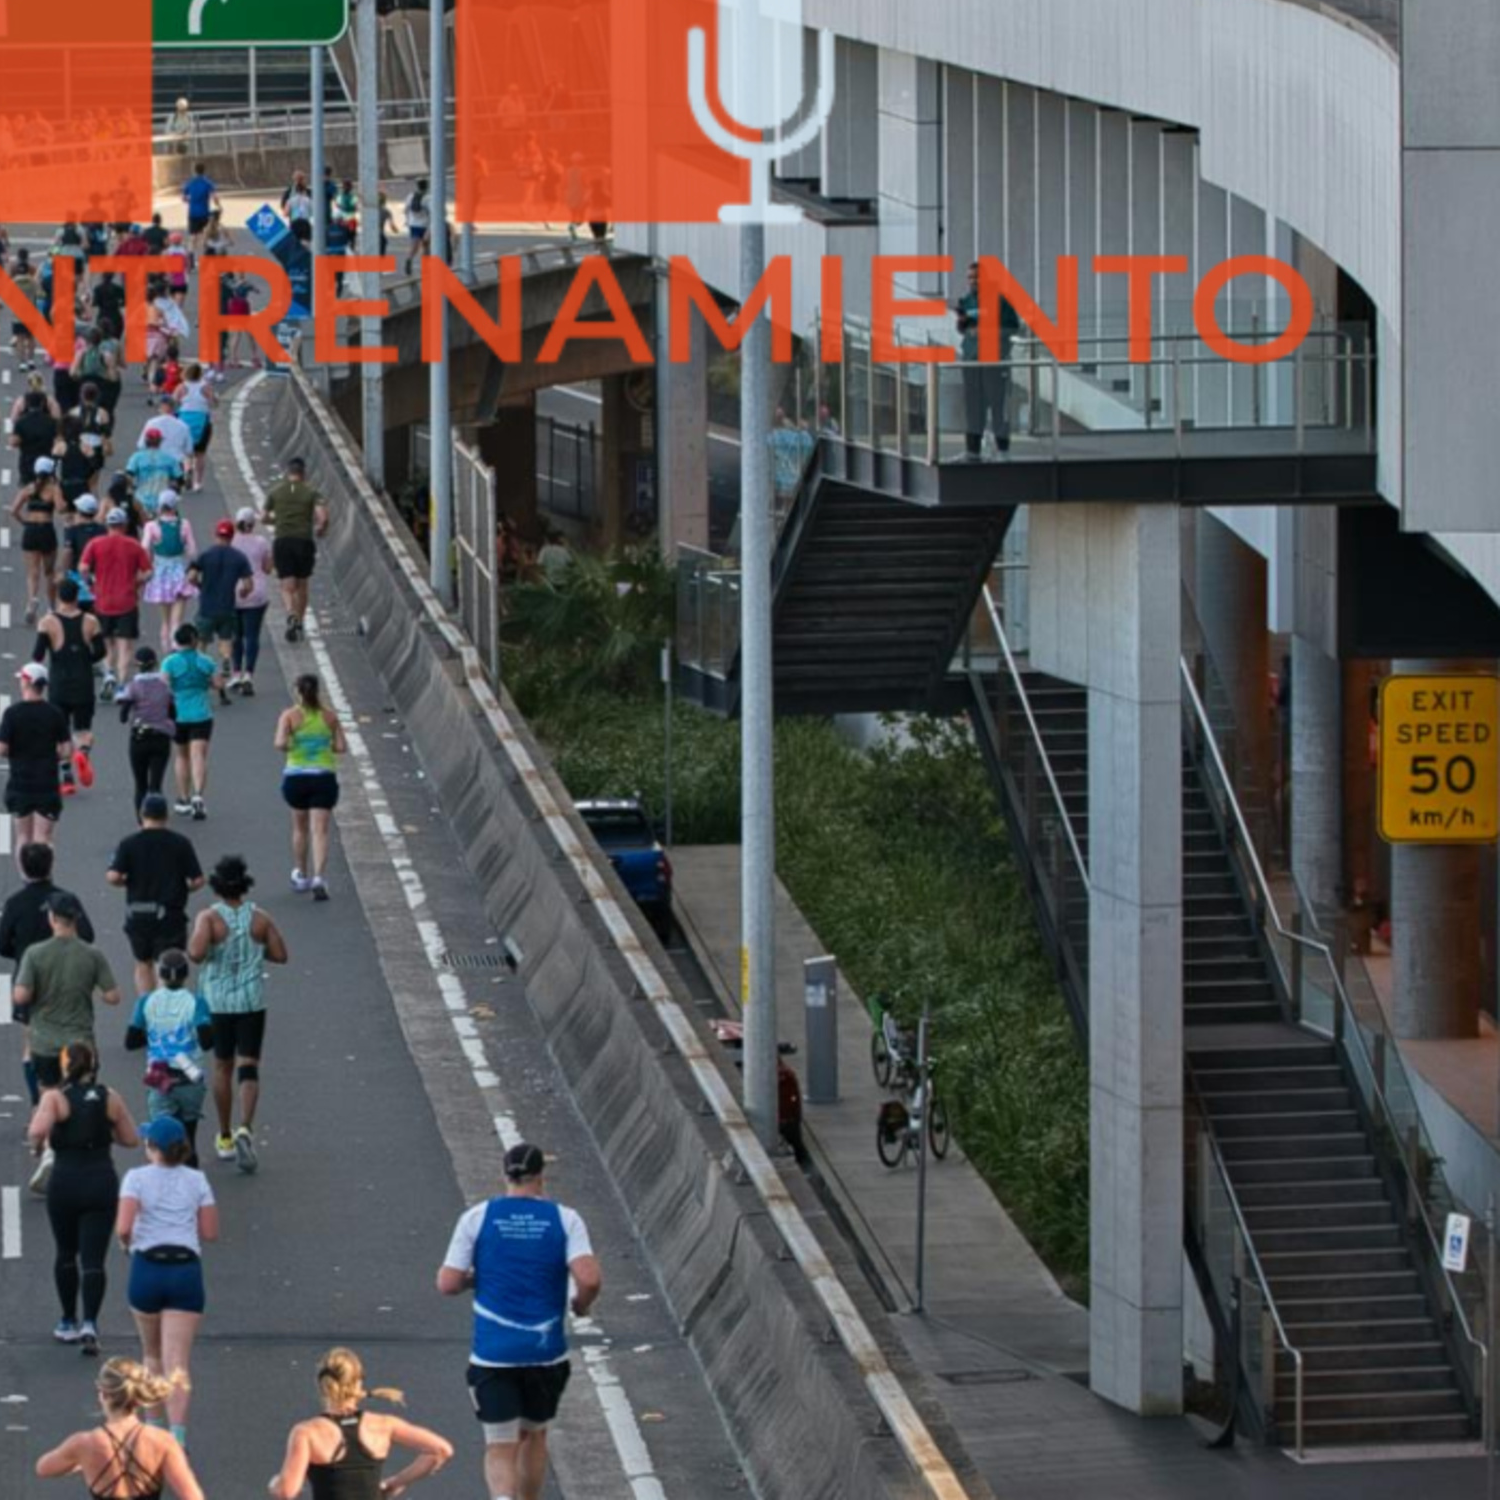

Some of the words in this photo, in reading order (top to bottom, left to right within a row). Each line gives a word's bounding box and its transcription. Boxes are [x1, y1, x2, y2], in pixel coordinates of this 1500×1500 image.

[1412, 690, 1474, 711] EXIT
[1396, 723, 1490, 744] SPEED
[1409, 754, 1476, 794] 50
[1409, 806, 1475, 829] km/h
